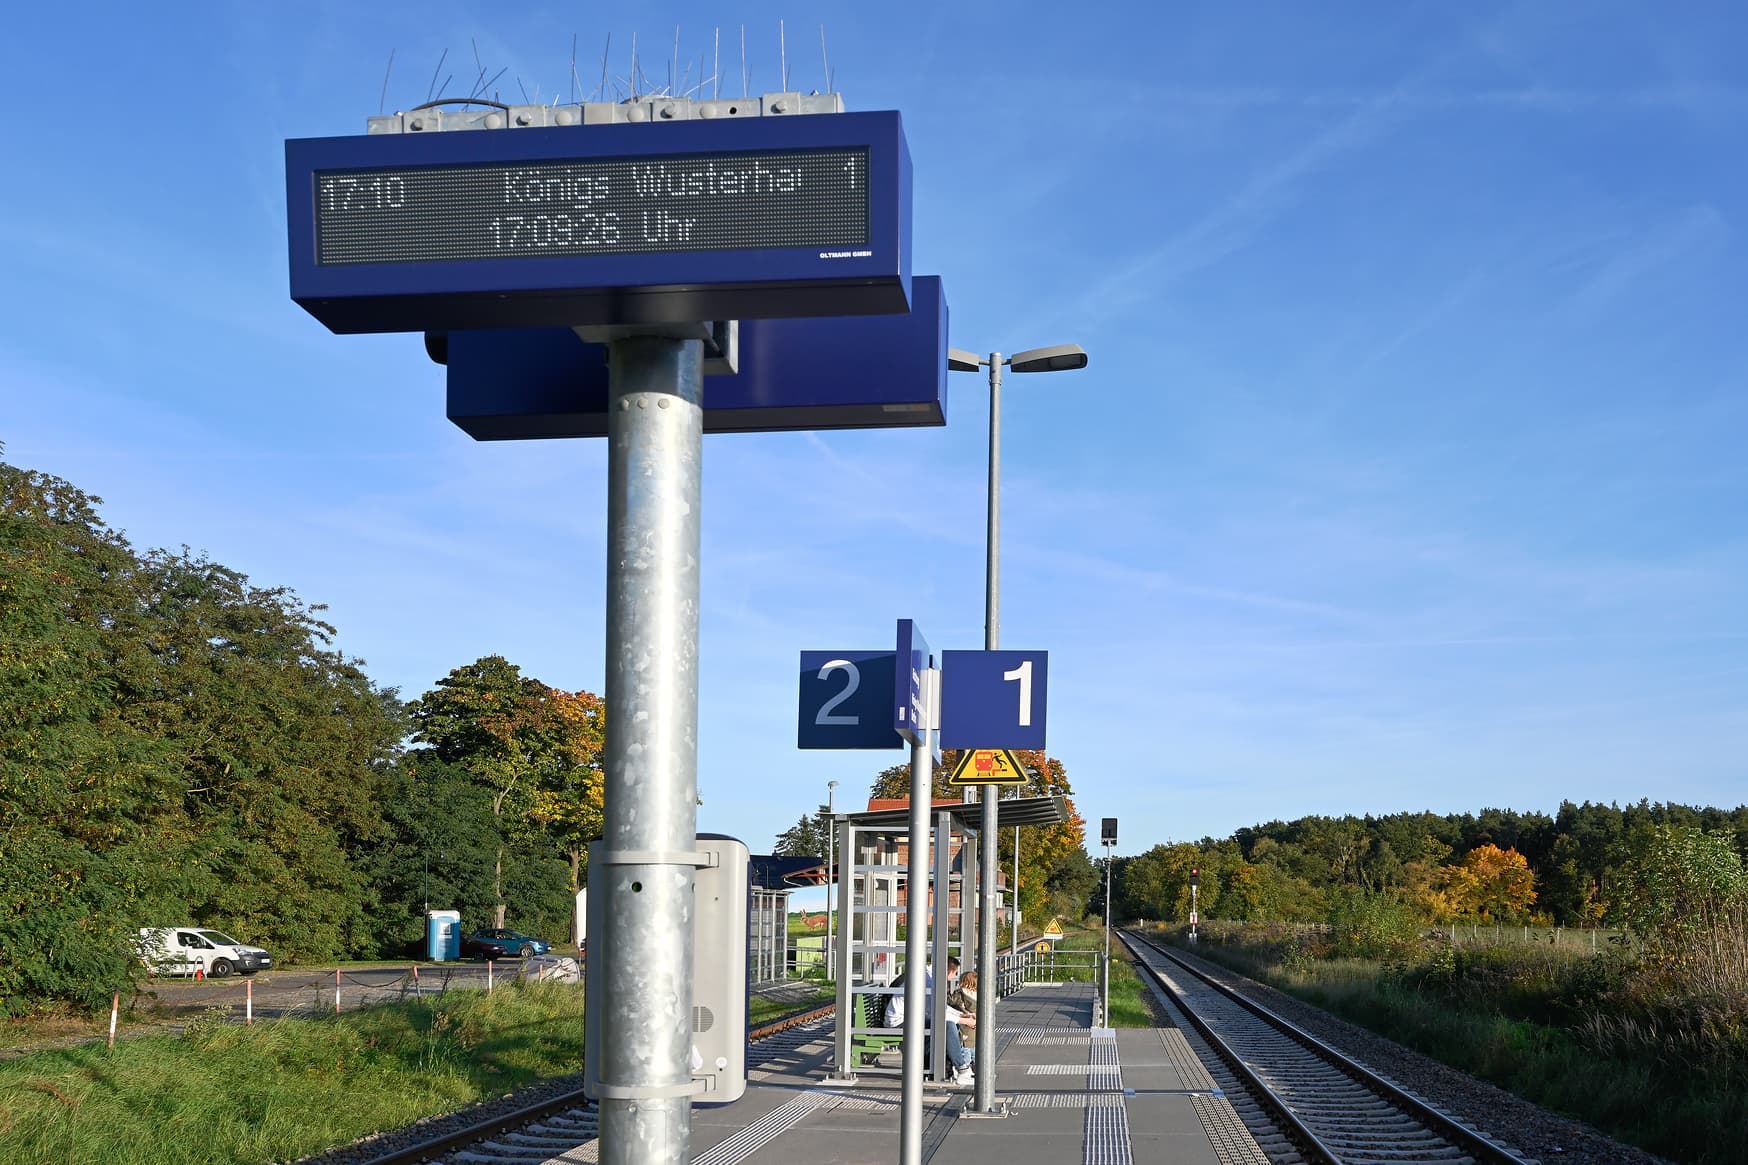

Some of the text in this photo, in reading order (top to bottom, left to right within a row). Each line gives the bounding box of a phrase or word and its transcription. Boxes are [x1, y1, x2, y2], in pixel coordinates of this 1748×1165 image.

[322, 176, 405, 210] 17:10
[505, 168, 610, 209] Königs
[843, 156, 856, 190] 1
[488, 210, 698, 248] 17:09:26 Uhr
[819, 251, 852, 259] OLTMANN
[815, 659, 861, 725] 2
[1004, 660, 1033, 726] 1
